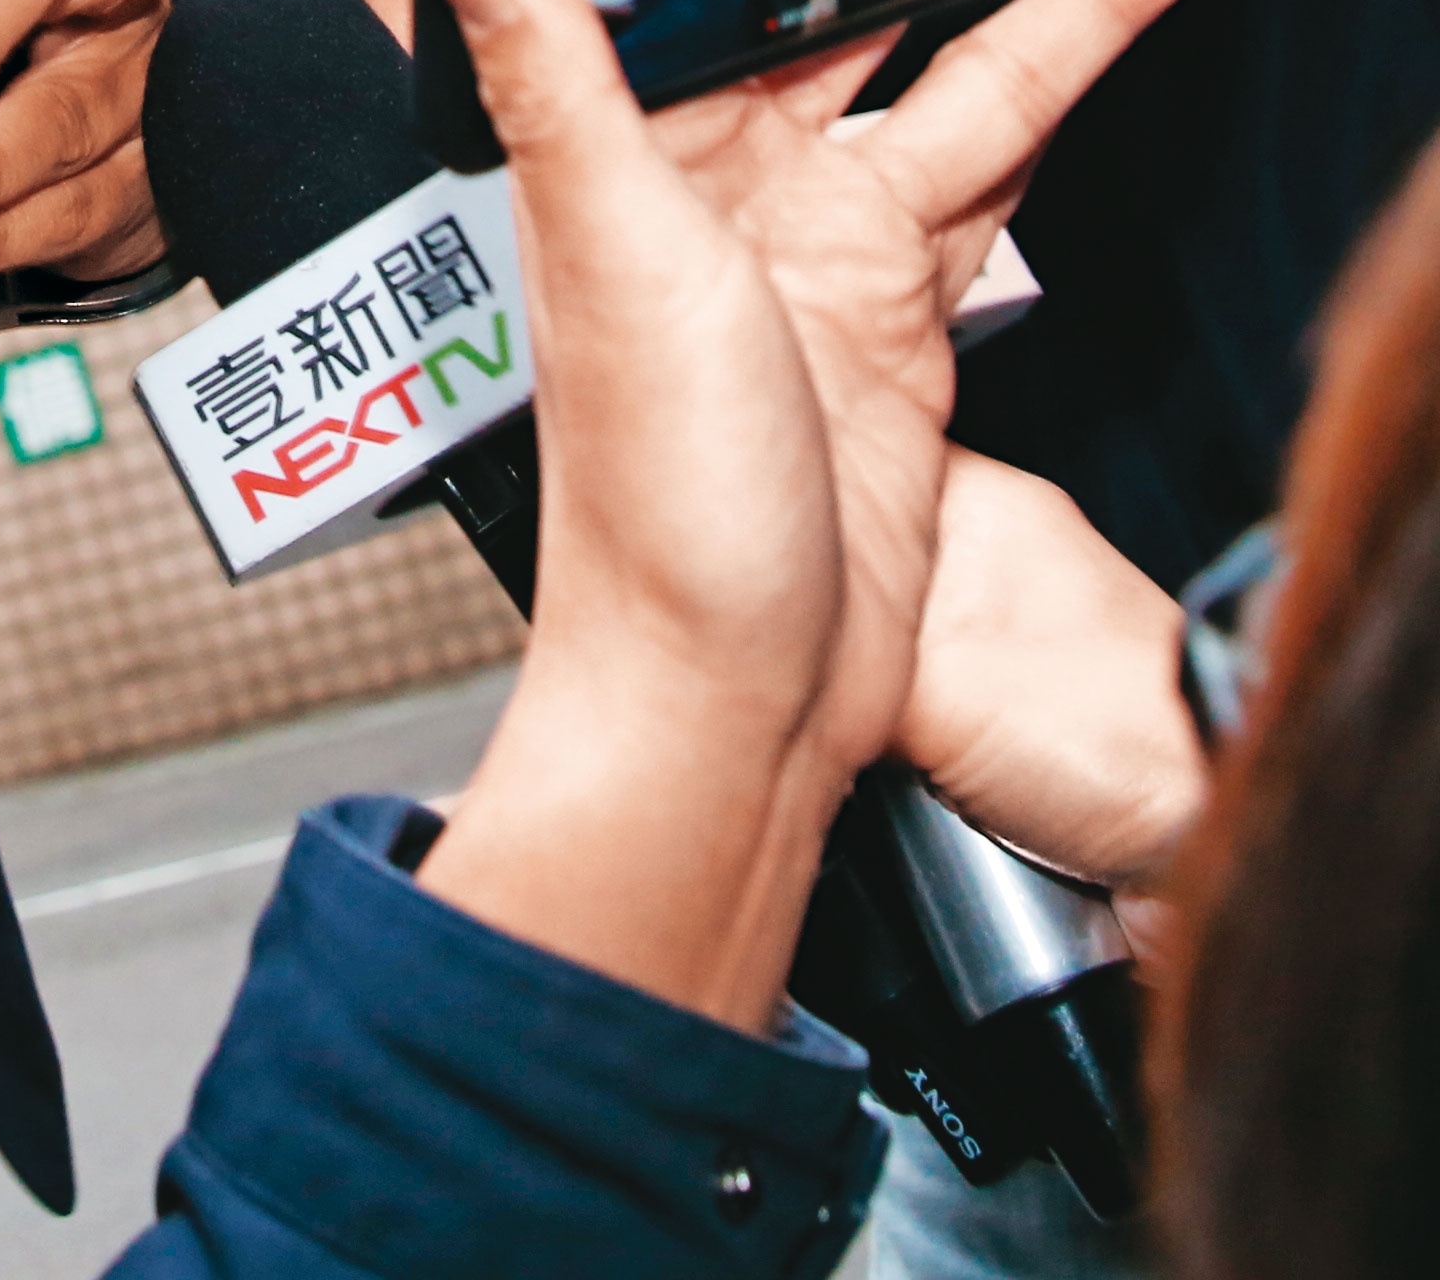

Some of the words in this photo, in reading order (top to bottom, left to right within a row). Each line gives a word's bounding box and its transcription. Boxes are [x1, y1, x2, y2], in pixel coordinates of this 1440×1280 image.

[186, 213, 496, 462] 壹新聞
[904, 1067, 982, 1160] SONY
